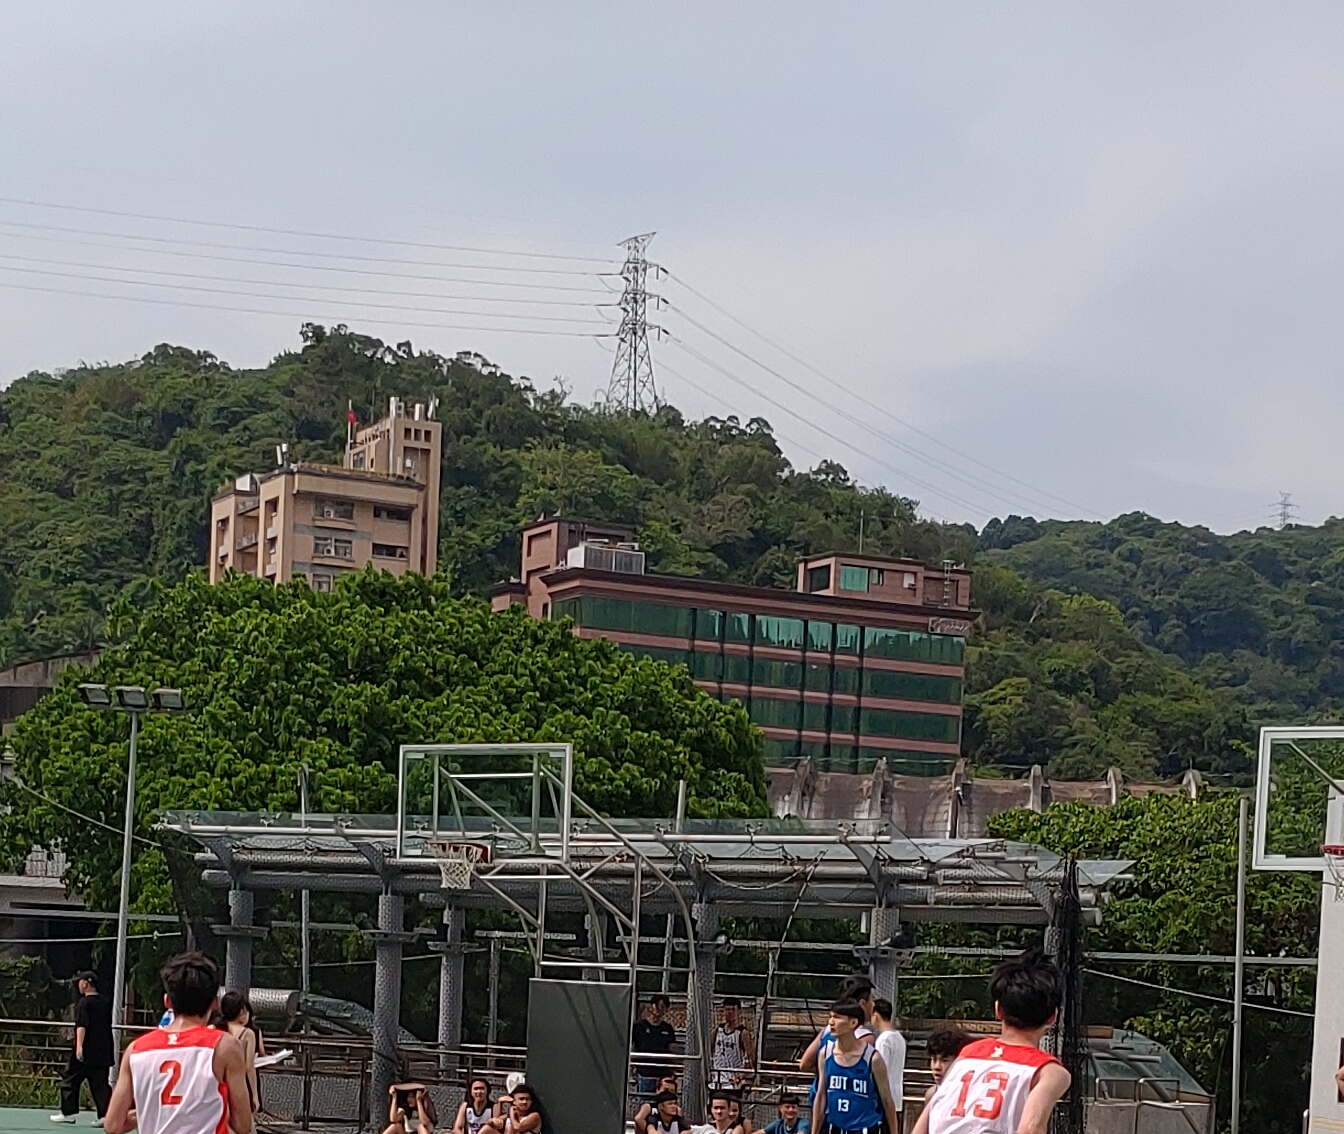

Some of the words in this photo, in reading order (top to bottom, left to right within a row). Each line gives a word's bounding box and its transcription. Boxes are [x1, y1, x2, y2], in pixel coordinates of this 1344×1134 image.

[159, 1060, 183, 1106] 2
[837, 1098, 850, 1112] 13
[950, 1070, 1010, 1120] 13
